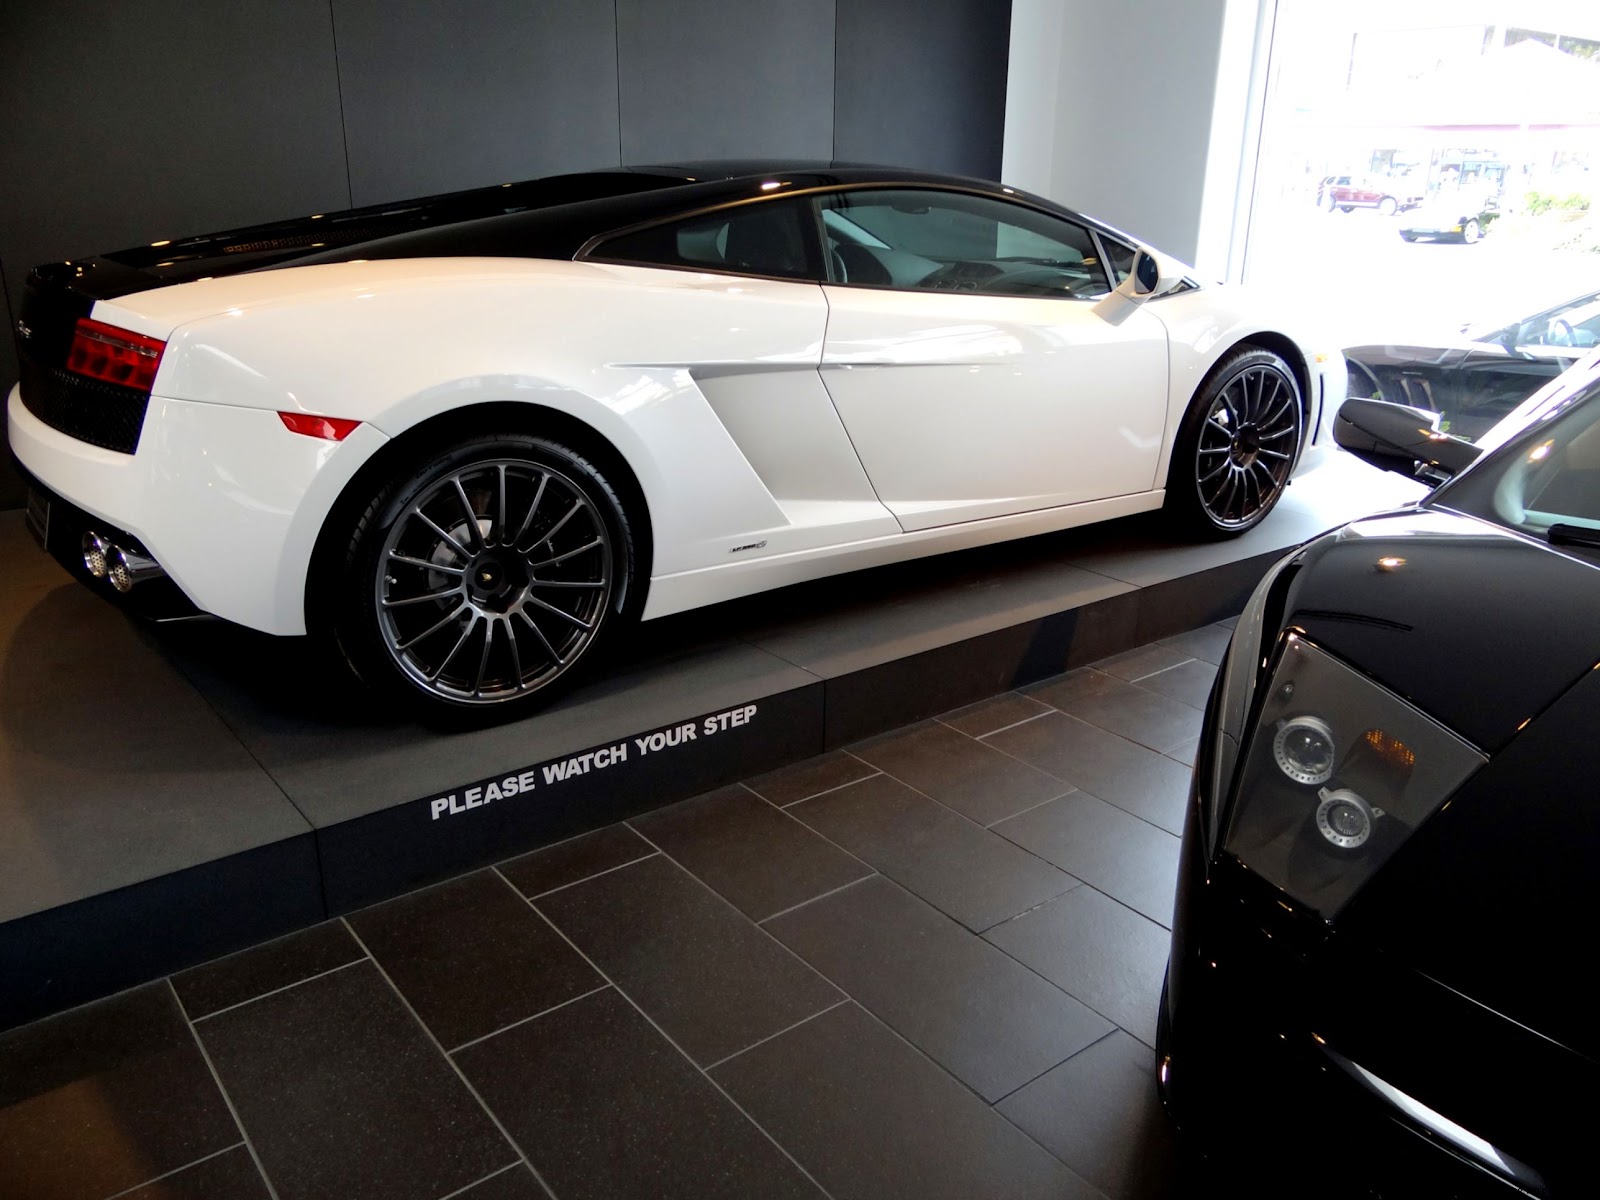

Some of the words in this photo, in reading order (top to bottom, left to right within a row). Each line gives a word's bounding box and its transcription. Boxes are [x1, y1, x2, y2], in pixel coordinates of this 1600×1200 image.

[430, 770, 536, 820] PLEASE
[542, 743, 627, 785] WATCH
[634, 723, 697, 756] YOUR
[703, 704, 757, 736] STEP
